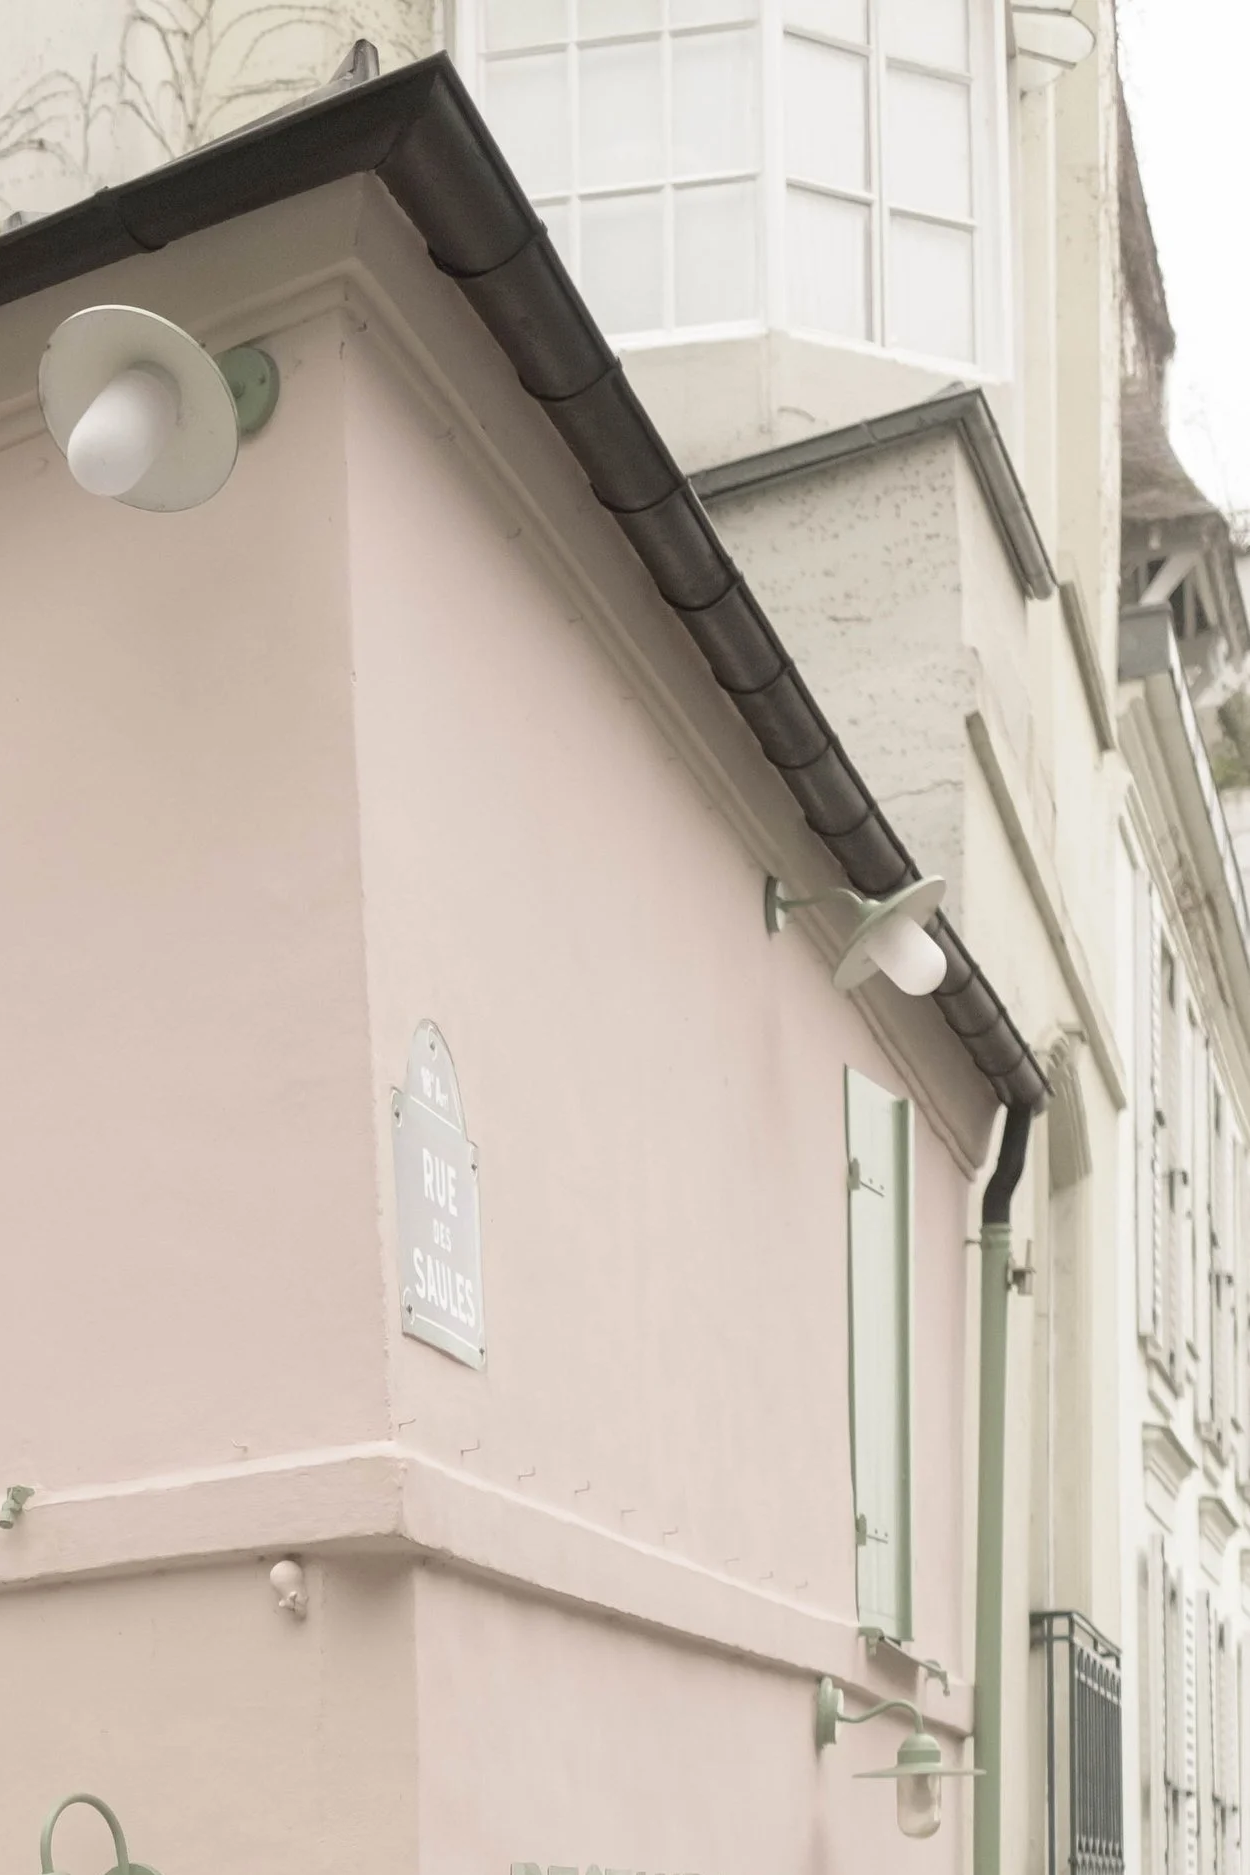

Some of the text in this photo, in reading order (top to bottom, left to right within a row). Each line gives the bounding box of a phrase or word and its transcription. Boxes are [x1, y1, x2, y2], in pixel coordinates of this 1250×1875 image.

[422, 1148, 458, 1217] RUE
[432, 1219, 452, 1252] DES
[412, 1247, 476, 1329] SAULES
